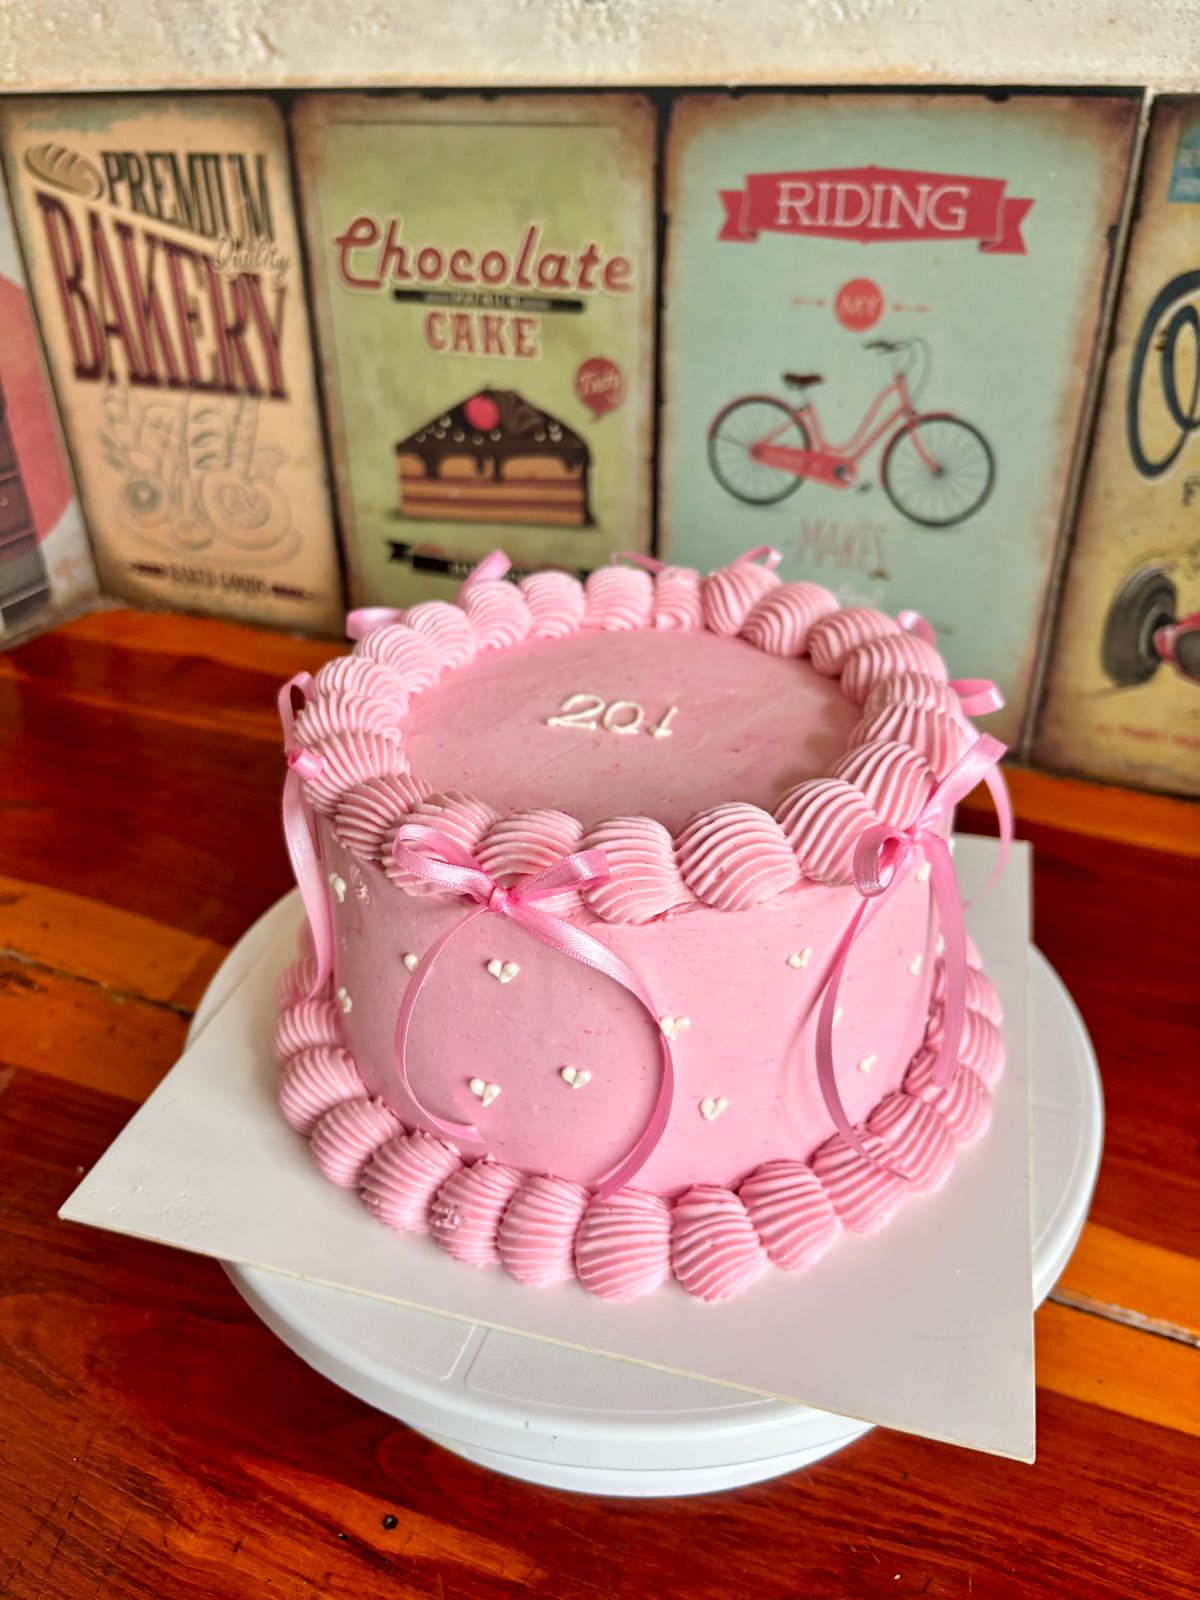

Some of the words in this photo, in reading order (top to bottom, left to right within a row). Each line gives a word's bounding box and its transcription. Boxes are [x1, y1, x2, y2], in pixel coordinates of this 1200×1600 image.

[104, 151, 275, 243] PREMIUM
[774, 180, 970, 233] RIDING
[335, 216, 634, 294] Chocolate
[35, 190, 290, 400] BAKERY
[425, 311, 539, 358] CAKE
